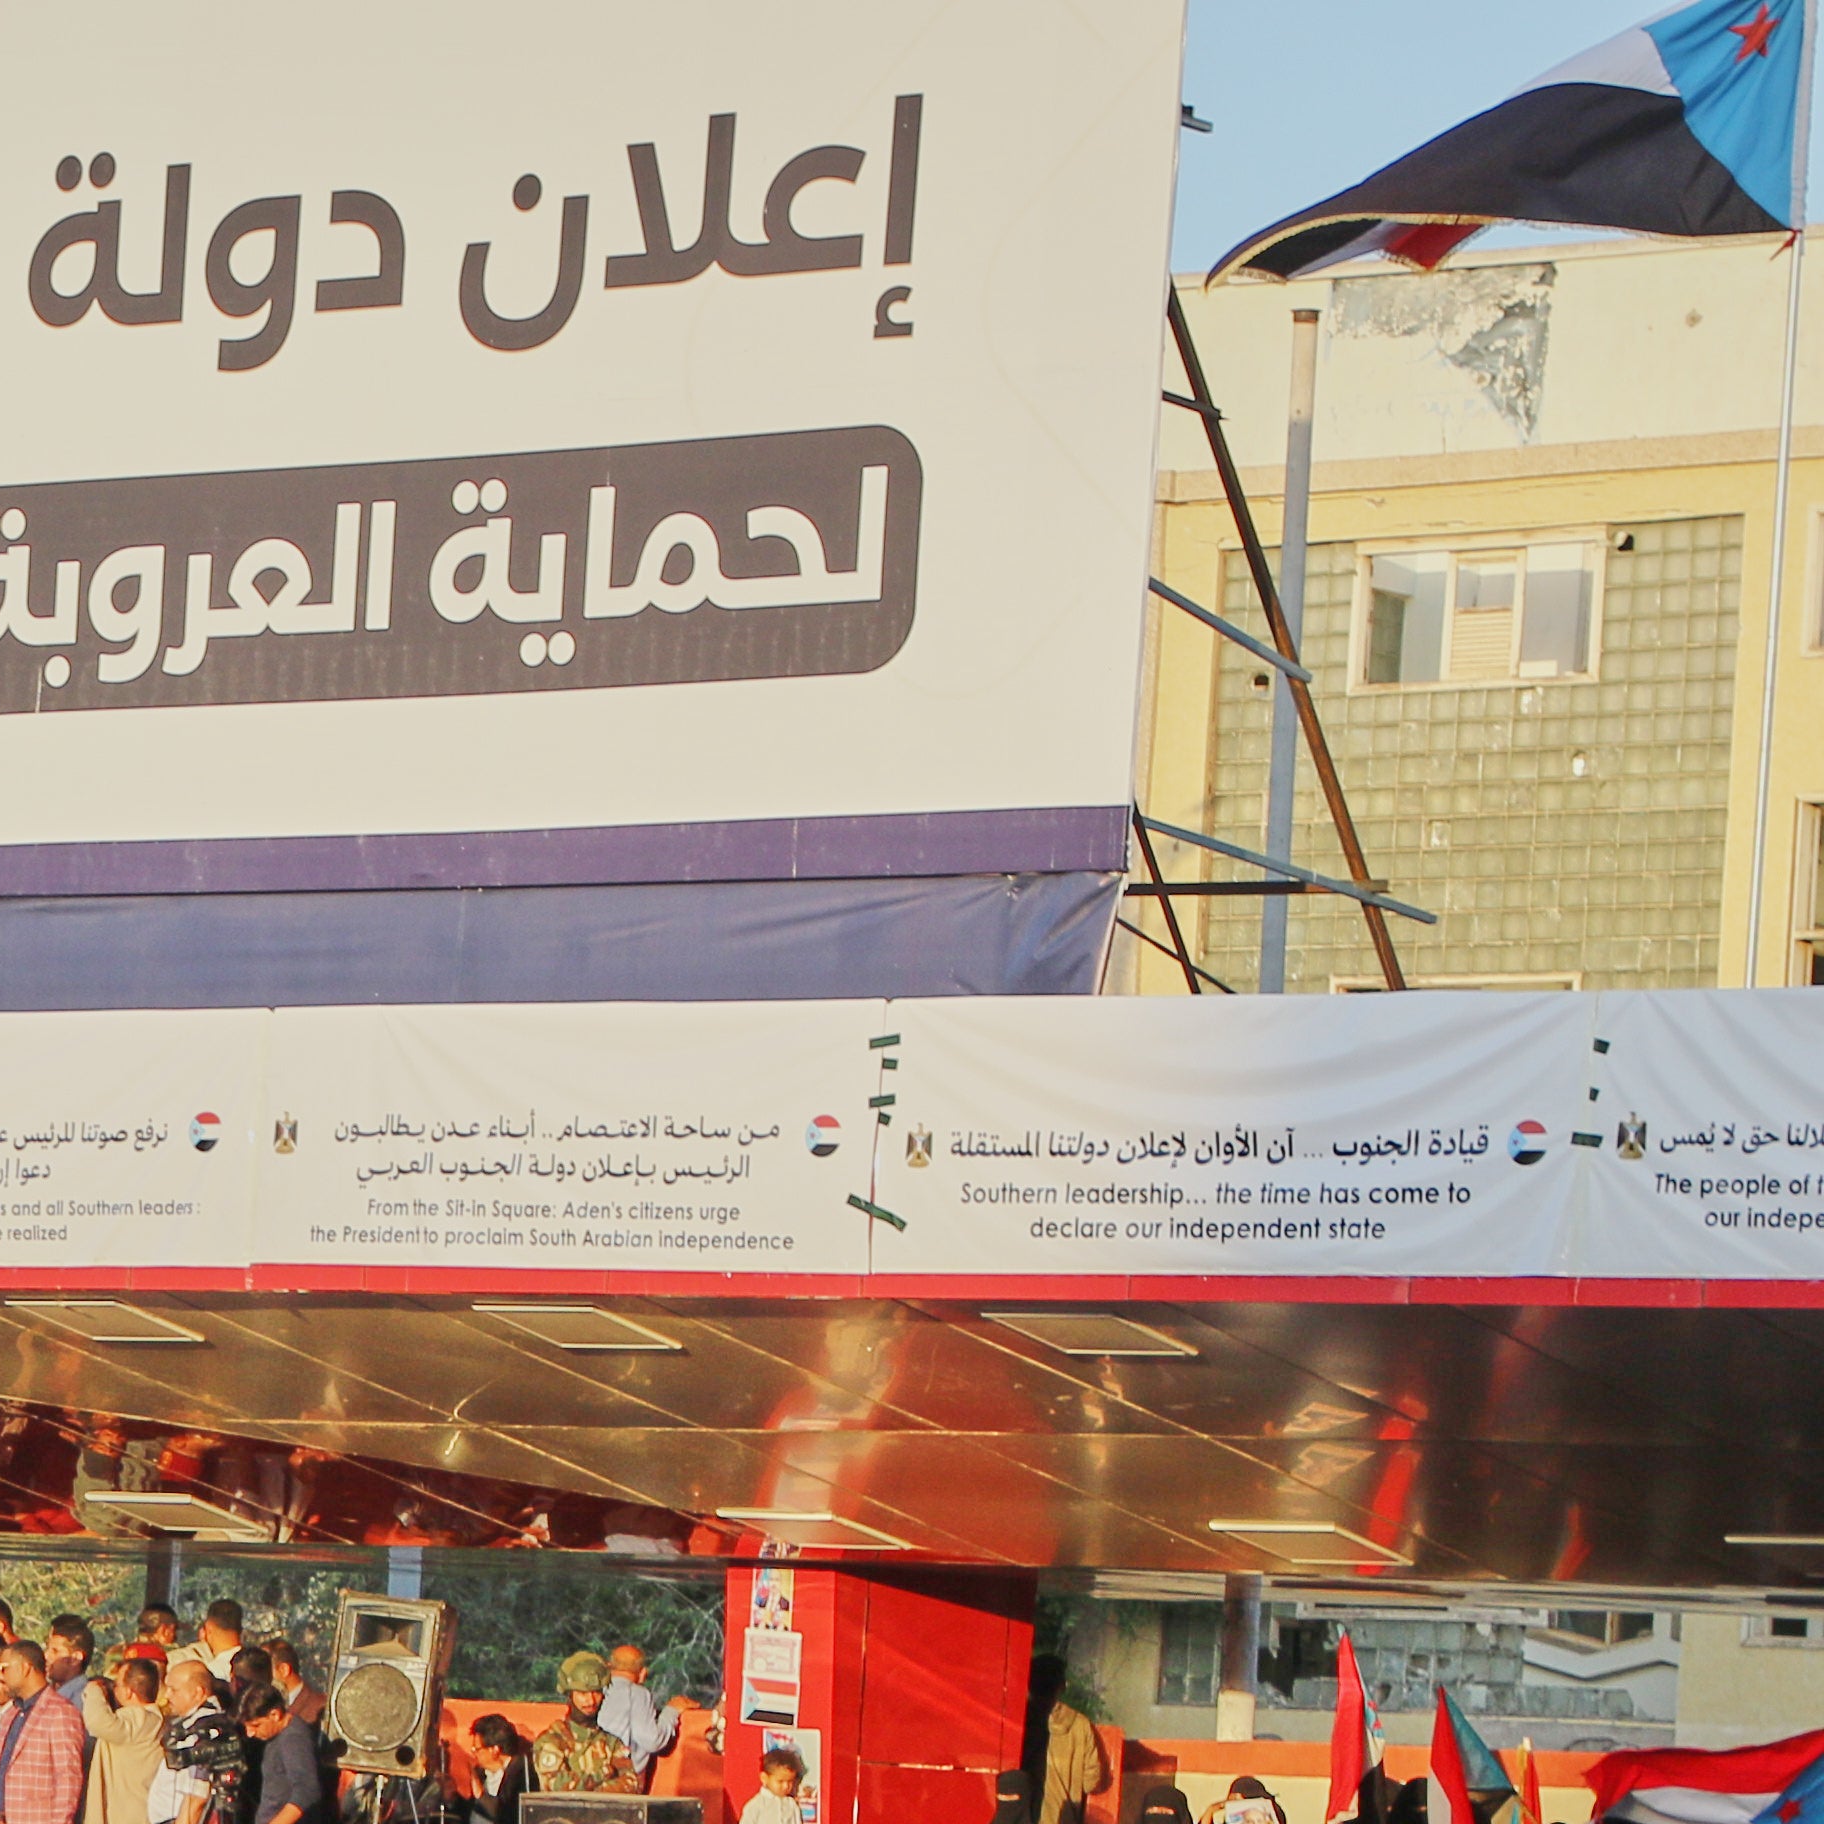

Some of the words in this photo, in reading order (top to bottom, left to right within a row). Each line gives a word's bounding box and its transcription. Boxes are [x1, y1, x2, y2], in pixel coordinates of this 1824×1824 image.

[460, 94, 923, 351] إعلان
[28, 151, 405, 371] دولة
[429, 463, 890, 664] لحماية
[13, 1122, 73, 1153] للرئيس
[82, 1122, 128, 1145] صوتنا
[133, 1122, 169, 1153] نرفع
[334, 1115, 425, 1143] يطالبون
[431, 1120, 481, 1142] عدن
[487, 1109, 536, 1141] أبناء
[557, 1115, 656, 1144] الاعتصام
[663, 1119, 731, 1141] ساحة
[738, 1122, 780, 1144] من
[1723, 1123, 1735, 1146] لا
[949, 1129, 1041, 1158] المستقلة
[1048, 1129, 1110, 1163] دولتنا
[1116, 1129, 1187, 1169] لإعلان
[1194, 1124, 1257, 1164] الأوان
[1266, 1126, 1294, 1164] آن
[1427, 1123, 1488, 1167] قيادة
[1742, 1126, 1779, 1153] حق
[15, 1159, 51, 1182] دعوا
[582, 1155, 655, 1186] بإعلان
[663, 1154, 750, 1184] الرئيس
[961, 1182, 1058, 1204] Southern
[1066, 1182, 1206, 1210] leadership...
[1216, 1183, 1252, 1205] the
[1260, 1182, 1310, 1205] time
[1318, 1183, 1359, 1204] has
[1368, 1187, 1439, 1204] come
[1655, 1173, 1691, 1194] The
[1701, 1173, 1781, 1199] people
[47, 1199, 63, 1217] all
[139, 1199, 194, 1216] leaders
[368, 1198, 408, 1217] From
[445, 1198, 486, 1218] Sit-in
[492, 1199, 556, 1222] Square:
[562, 1201, 623, 1220] Aden's
[628, 1201, 693, 1221] citizens
[698, 1206, 740, 1225] urge
[1705, 1211, 1740, 1227] our
[1747, 1207, 1824, 1233] indepe
[8, 1224, 66, 1241] realized
[343, 1225, 419, 1244] President
[444, 1227, 523, 1248] proclaim
[529, 1228, 577, 1247] South
[582, 1229, 651, 1248] Arabian
[658, 1229, 794, 1253] independence
[1030, 1216, 1117, 1239] declare
[1125, 1222, 1162, 1239] our
[1169, 1217, 1322, 1244] independent
[1328, 1217, 1385, 1239] state
